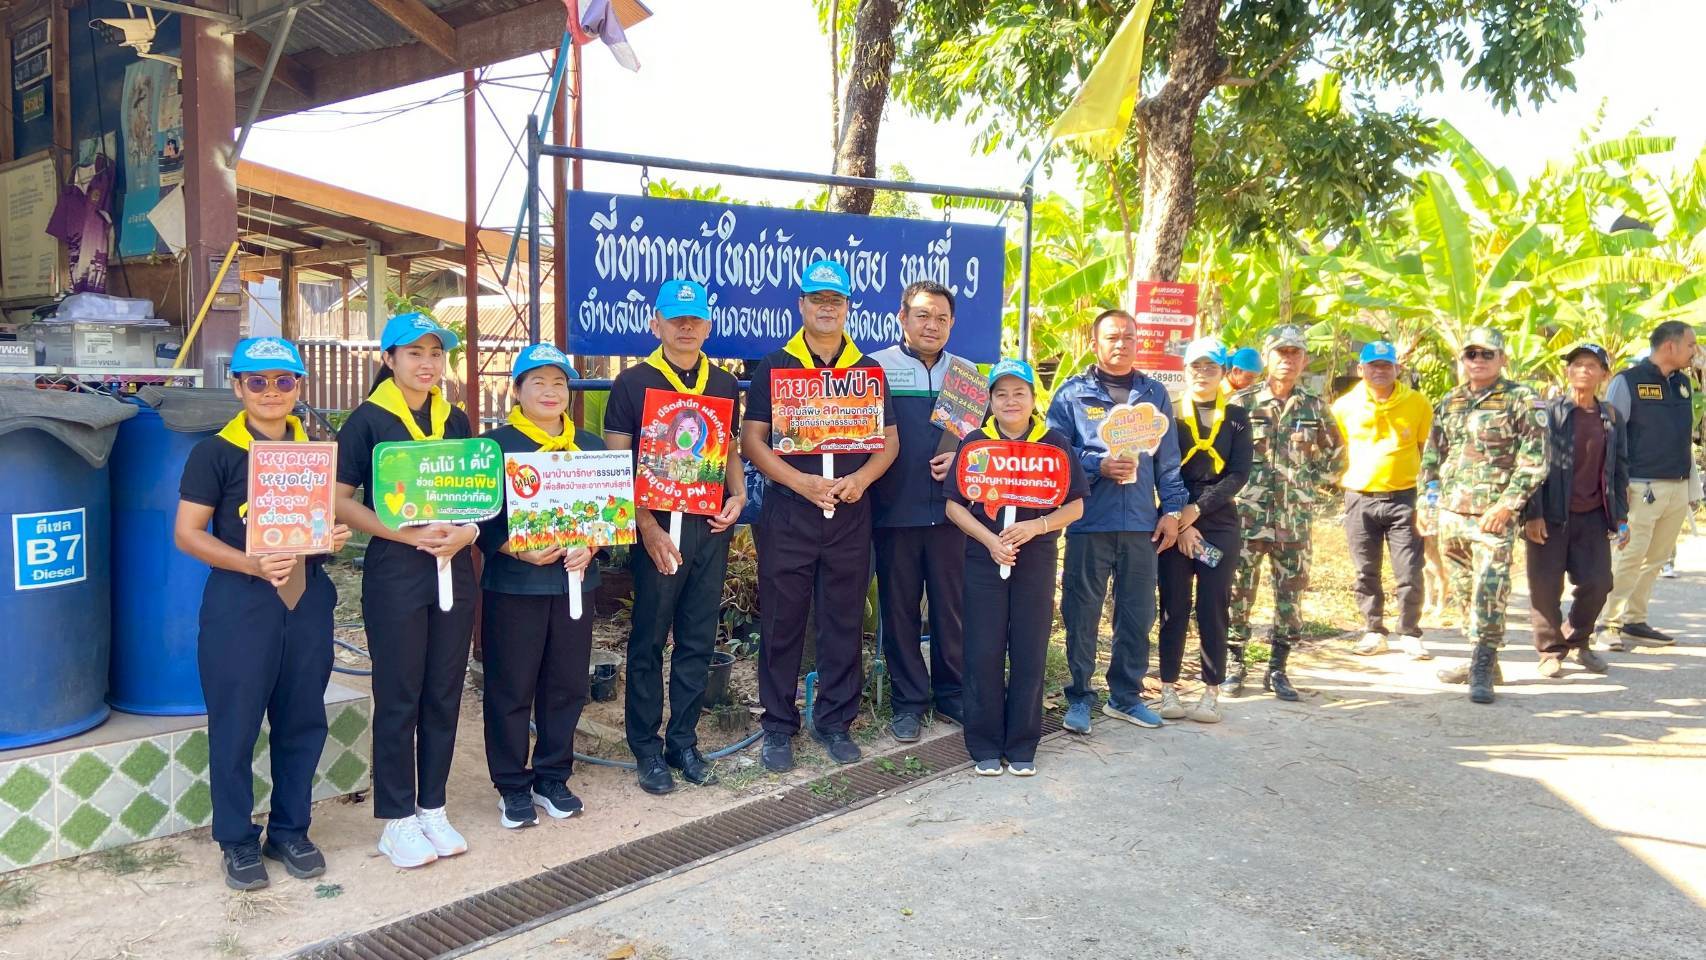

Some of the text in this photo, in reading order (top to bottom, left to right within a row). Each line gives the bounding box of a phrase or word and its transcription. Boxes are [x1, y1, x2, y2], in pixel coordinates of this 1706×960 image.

[0, 345, 28, 354] PIXM
[775, 370, 881, 406] หยุดไฟป่า
[954, 376, 988, 406] 1362
[778, 405, 821, 417] ลดมลพิษ
[257, 452, 330, 471] หยุดเผา
[419, 453, 490, 473] ต้นไม้ 1 ต้น
[991, 456, 1055, 473] งดเผา
[259, 468, 328, 491] หยุดฝุ่น
[416, 474, 497, 489] ช่วยลดมลพิษ
[515, 474, 537, 488] หยุด
[964, 475, 1057, 489] ลดปัญหาหมอกควัน
[257, 489, 308, 510] เพื่อคุณ
[426, 490, 493, 503] ได้มากกว่าที่คิด
[687, 485, 707, 497] PM
[258, 508, 305, 525] เพื่อเรา
[36, 518, 71, 535] ดีเซล
[26, 534, 81, 566] B7
[33, 565, 75, 581] Diesel
